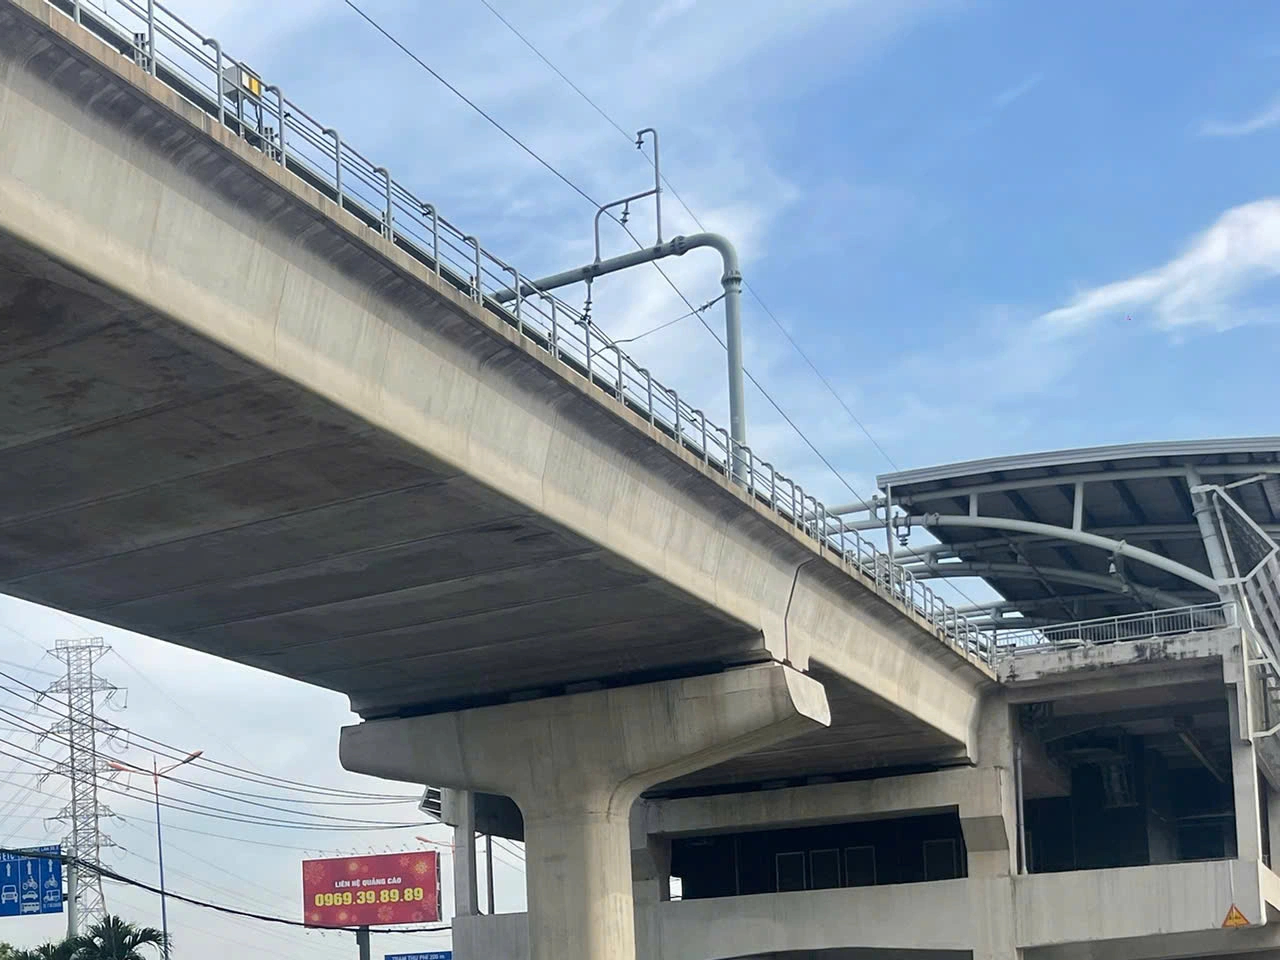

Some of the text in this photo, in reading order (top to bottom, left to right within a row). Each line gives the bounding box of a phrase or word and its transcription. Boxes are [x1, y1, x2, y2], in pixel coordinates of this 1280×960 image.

[335, 879, 351, 888] LIÊN
[362, 877, 386, 887] QUẢNG
[387, 876, 402, 885] CÁO
[314, 887, 424, 907] 0969.39.89.89
